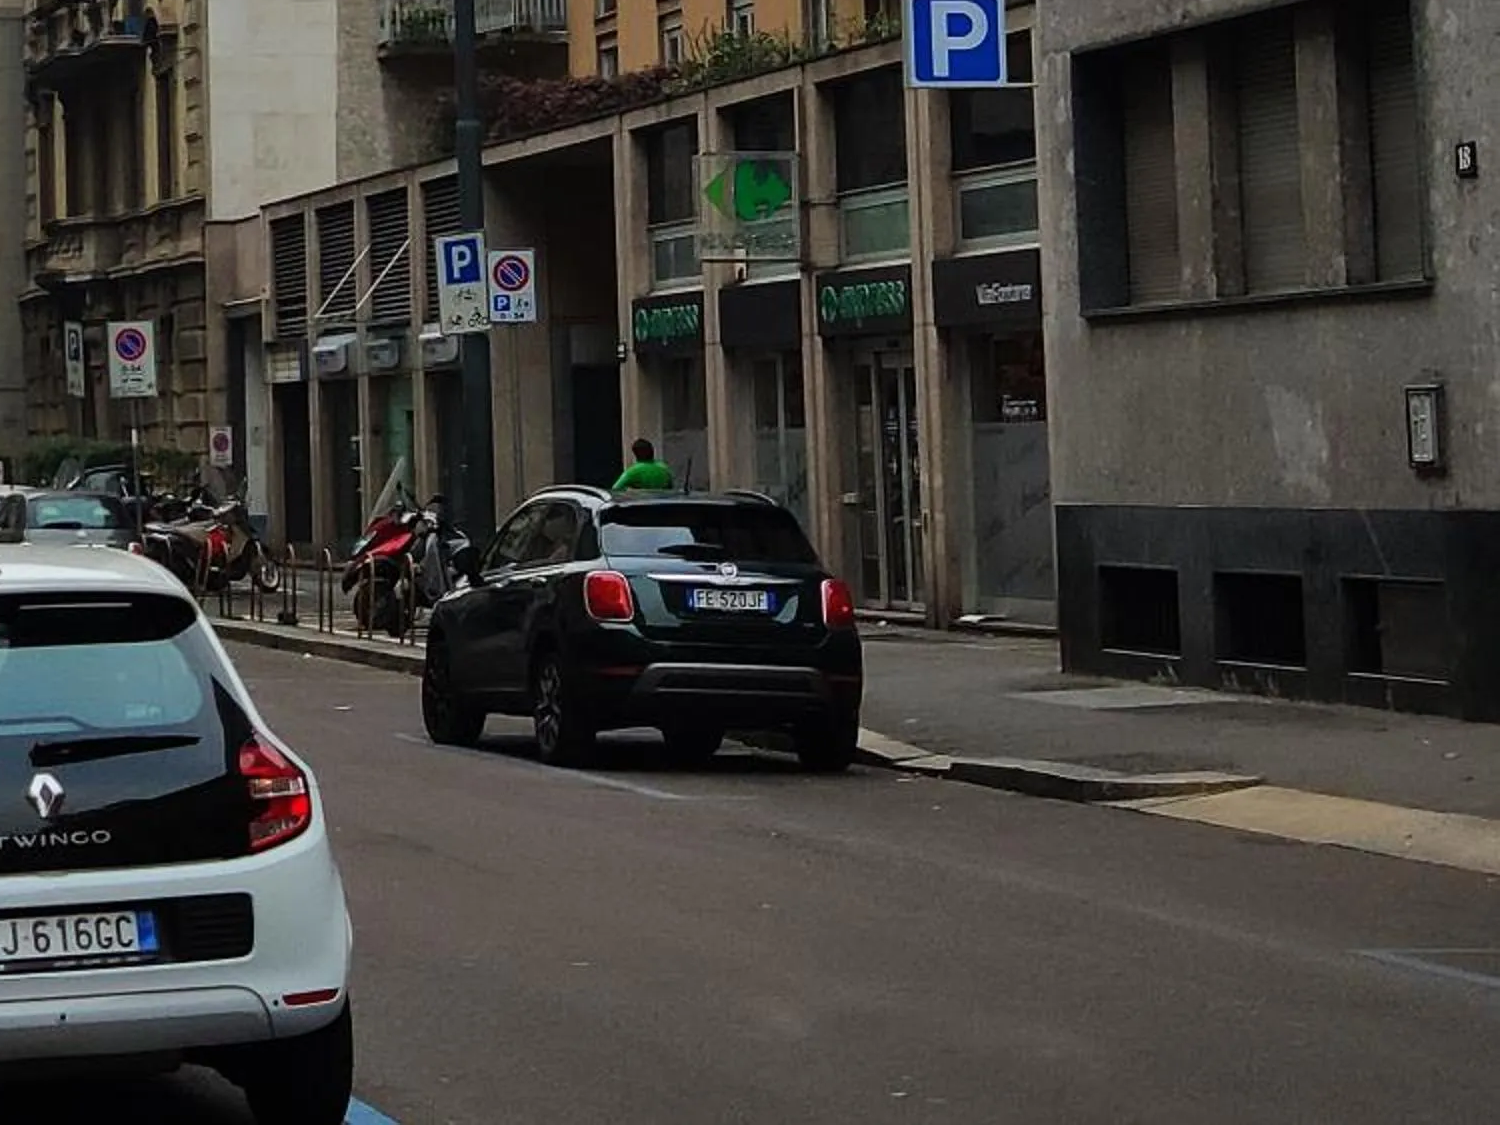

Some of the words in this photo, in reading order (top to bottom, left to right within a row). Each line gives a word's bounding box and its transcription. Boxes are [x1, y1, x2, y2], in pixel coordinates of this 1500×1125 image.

[930, 0, 989, 78] P
[451, 245, 472, 279] P
[496, 296, 508, 310] P
